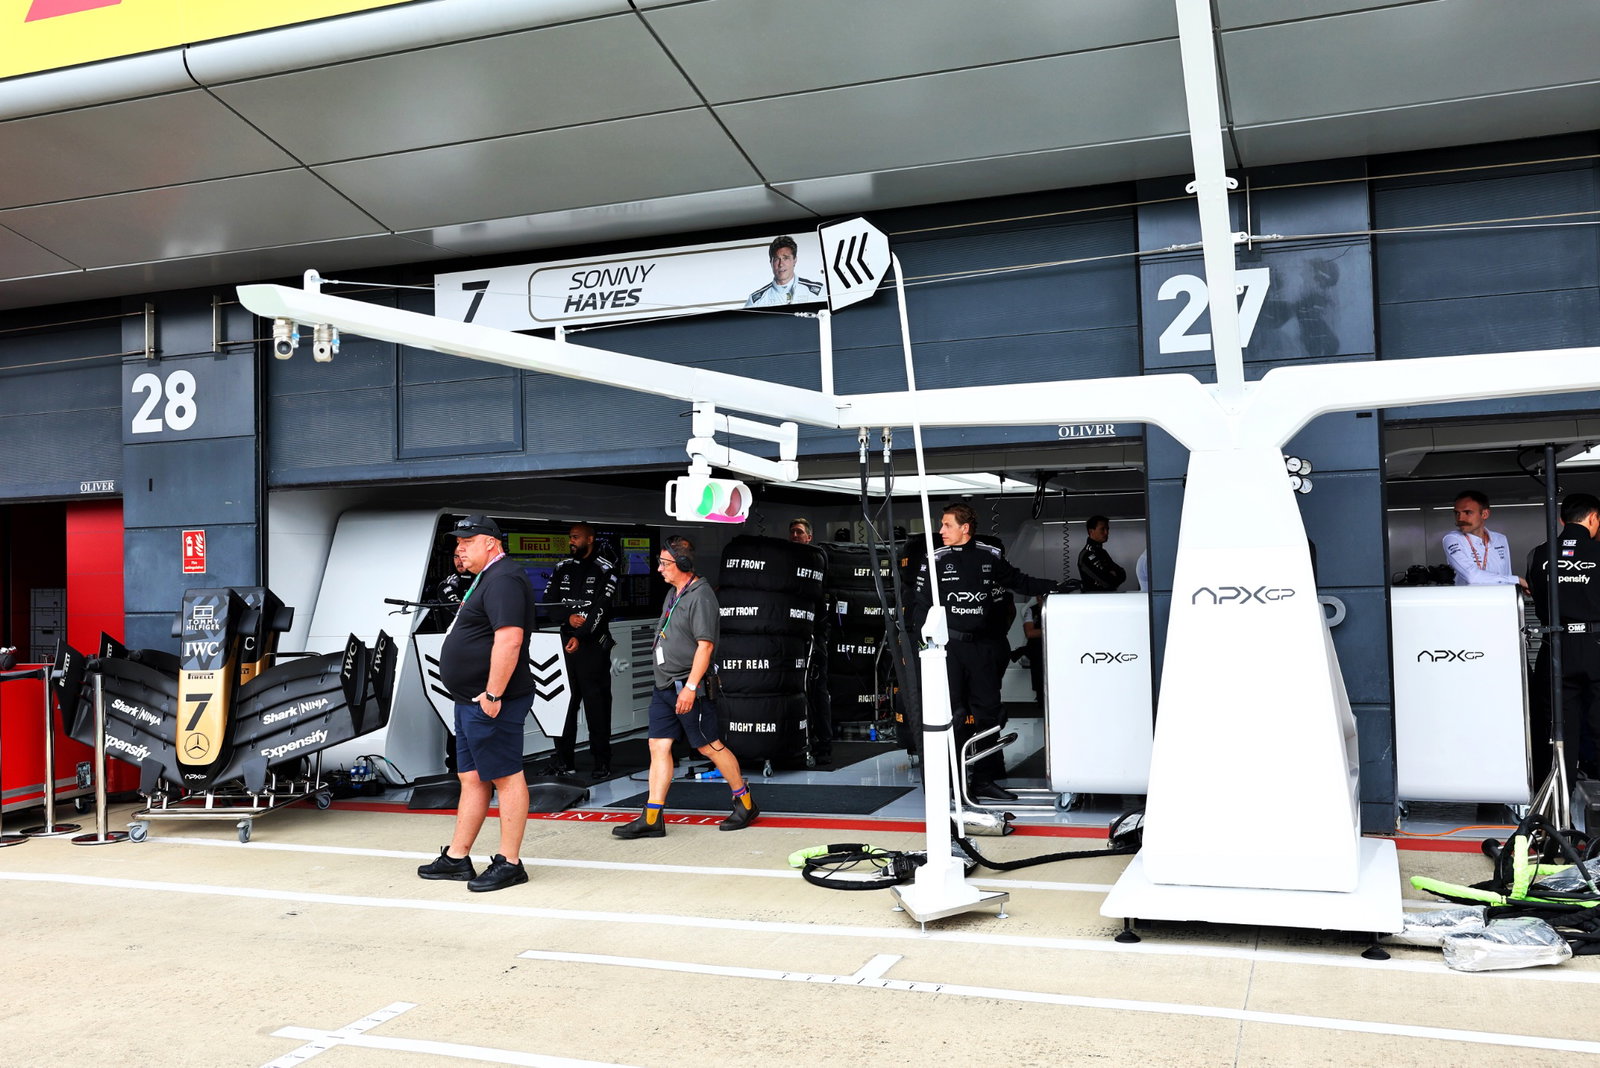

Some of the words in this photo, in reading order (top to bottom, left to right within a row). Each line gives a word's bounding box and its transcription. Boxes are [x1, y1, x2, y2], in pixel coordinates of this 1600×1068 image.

[569, 263, 656, 290] SONNY
[462, 280, 490, 323] 7
[564, 288, 643, 313] HAYES
[1157, 267, 1270, 354] 27
[131, 370, 197, 434] 28
[1058, 424, 1116, 438] OLIVER
[80, 482, 114, 492] OLIVER
[520, 537, 550, 550] PIRELLI
[726, 559, 739, 568] LEFT
[741, 560, 765, 570] FRONT
[1543, 560, 1596, 571] PXGP
[797, 567, 812, 578] LEFT
[854, 568, 870, 577] LEFT
[1547, 574, 1590, 585] pensify
[735, 606, 759, 616] FRONT
[1567, 623, 1586, 634] OMP
[184, 641, 219, 657] IWC
[374, 638, 386, 673] IWC
[837, 643, 855, 654] LEFT
[343, 642, 358, 679] IWC
[722, 659, 743, 669] LEFT
[746, 659, 770, 669] REAR
[112, 699, 139, 717] Shark
[138, 709, 162, 726] NINJA
[185, 693, 213, 731] 7
[263, 706, 298, 725] Shark
[300, 698, 329, 714] NINJA
[729, 721, 754, 732] RIGHT
[755, 723, 777, 733] REAR
[104, 733, 151, 762] xpensify
[261, 730, 328, 758] Expensify
